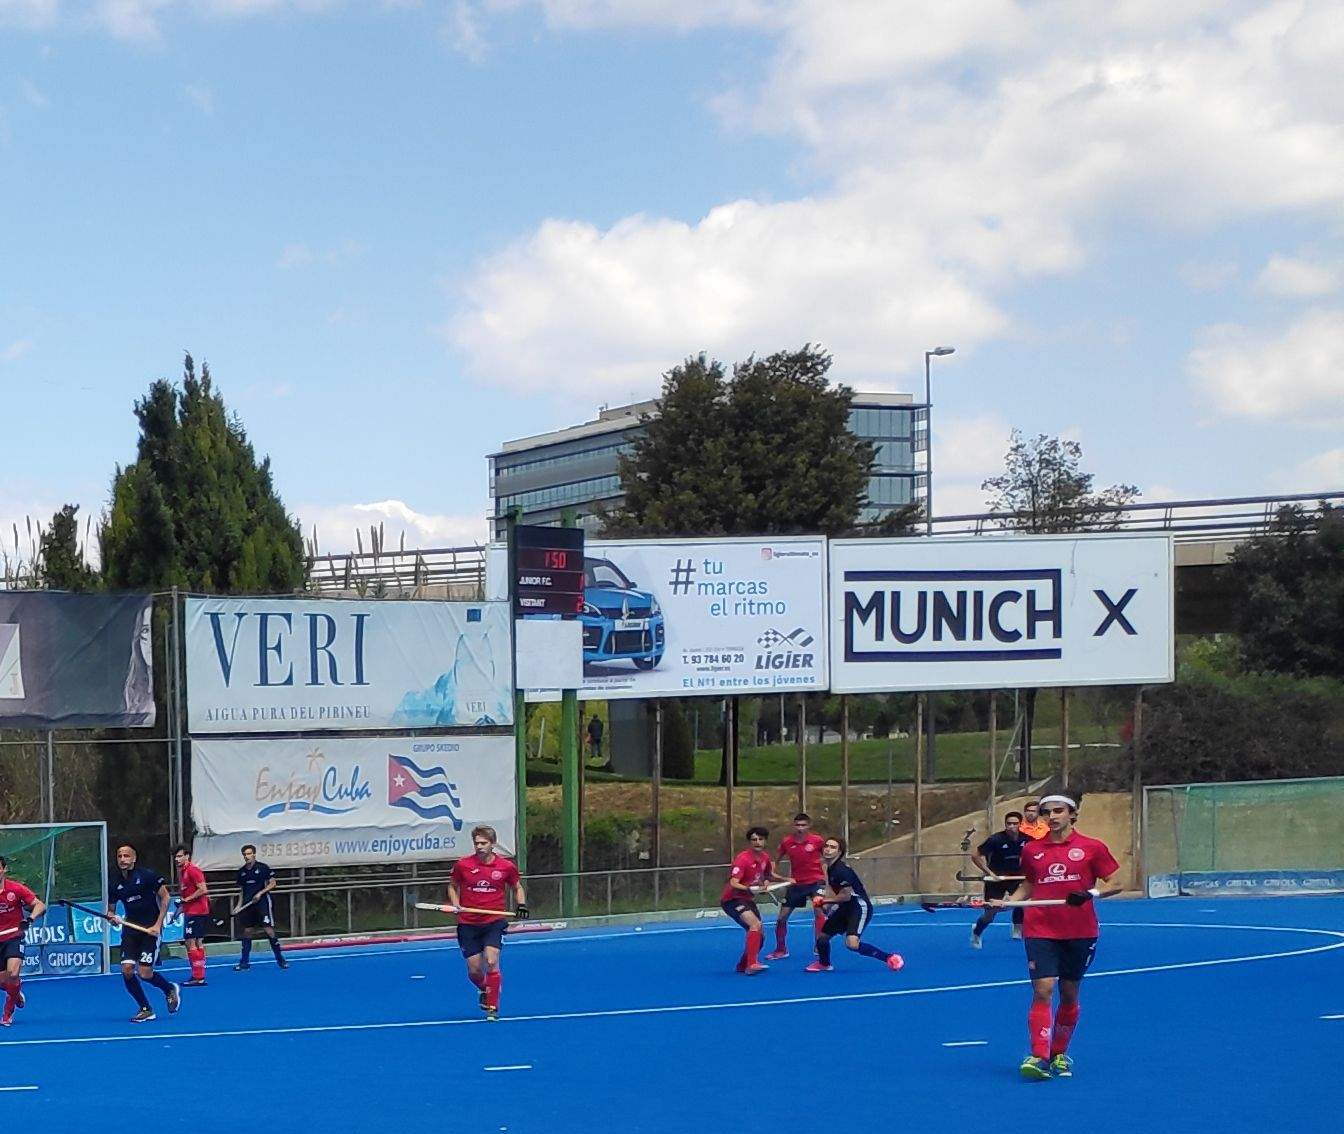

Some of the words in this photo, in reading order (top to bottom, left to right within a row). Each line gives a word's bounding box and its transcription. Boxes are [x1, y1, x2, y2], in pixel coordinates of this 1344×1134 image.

[703, 558, 723, 575] tu
[697, 580, 768, 596] marcas
[710, 598, 727, 616] el
[734, 597, 786, 616] ritmo
[844, 587, 1062, 645] MUNICH
[1092, 588, 1139, 637] X
[204, 611, 372, 689] VERI
[691, 654, 702, 664] 93
[733, 653, 745, 663] 20
[682, 678, 694, 688] El
[720, 677, 749, 687] entre
[753, 675, 770, 686] los
[772, 674, 816, 687] jóvenes
[205, 707, 247, 722] AIGUA
[251, 706, 286, 721] PURA
[290, 706, 314, 721] DEL
[317, 704, 371, 720] PIRINEU
[323, 765, 372, 801] Cuba
[335, 833, 456, 856] www.enjoycuba.es
[22, 925, 66, 945] IFOLS
[48, 952, 96, 967] GRIFOLS
[140, 951, 153, 963] 26
